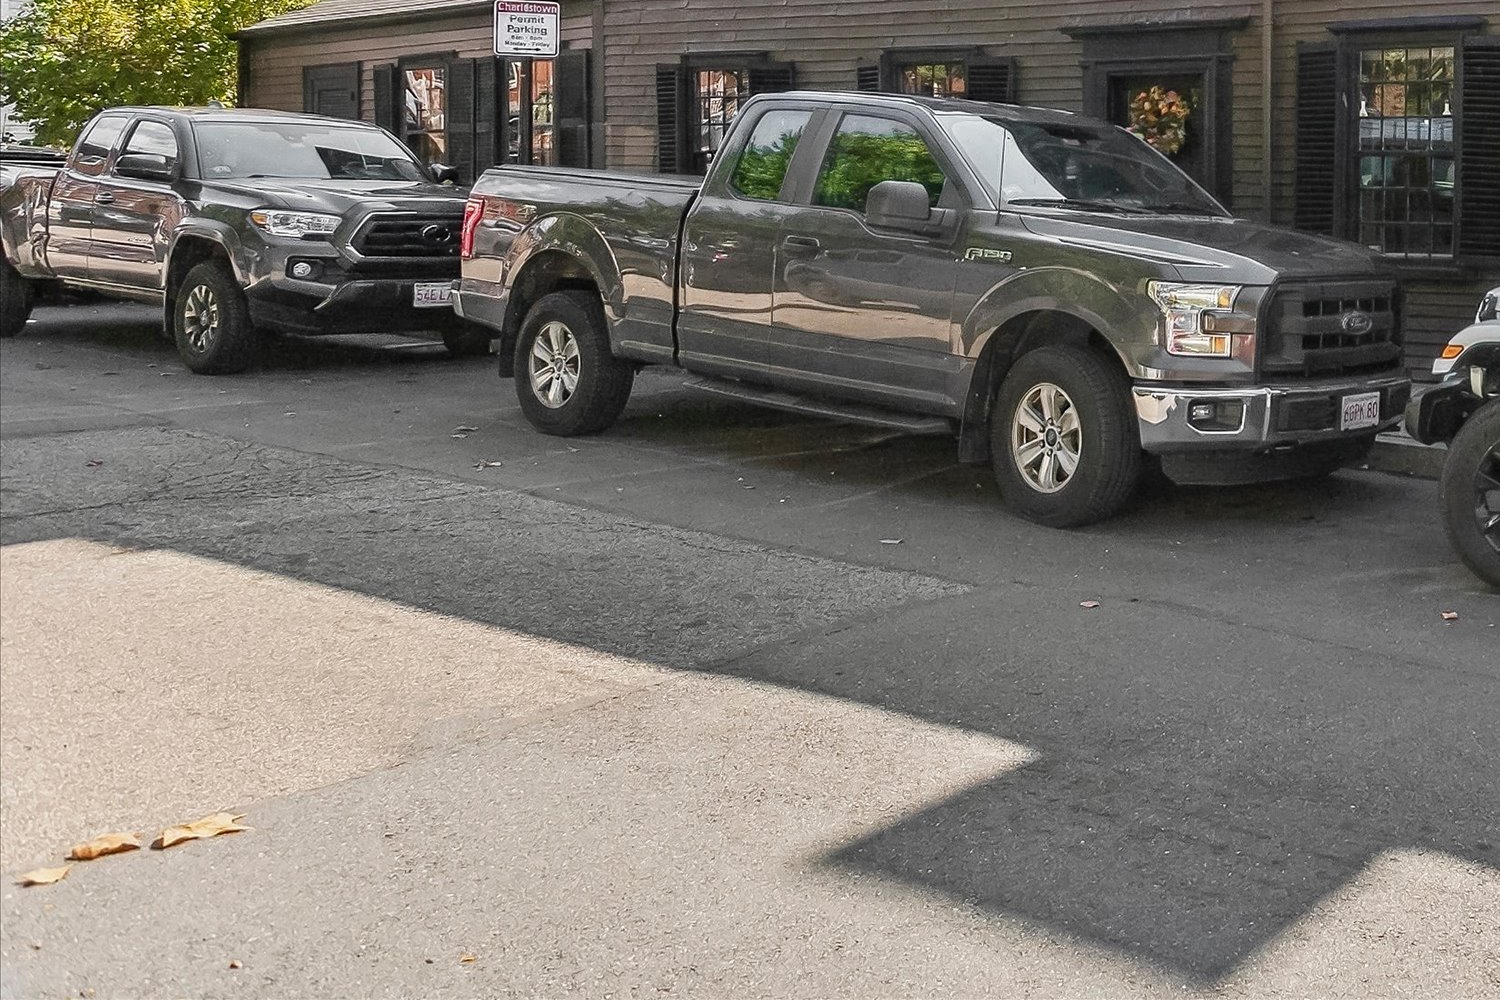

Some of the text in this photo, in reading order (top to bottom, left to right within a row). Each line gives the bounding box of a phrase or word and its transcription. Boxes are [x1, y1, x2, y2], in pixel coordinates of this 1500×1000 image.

[498, 2, 557, 13] Charlestown
[510, 15, 545, 23] Permit
[507, 25, 548, 36] Parking
